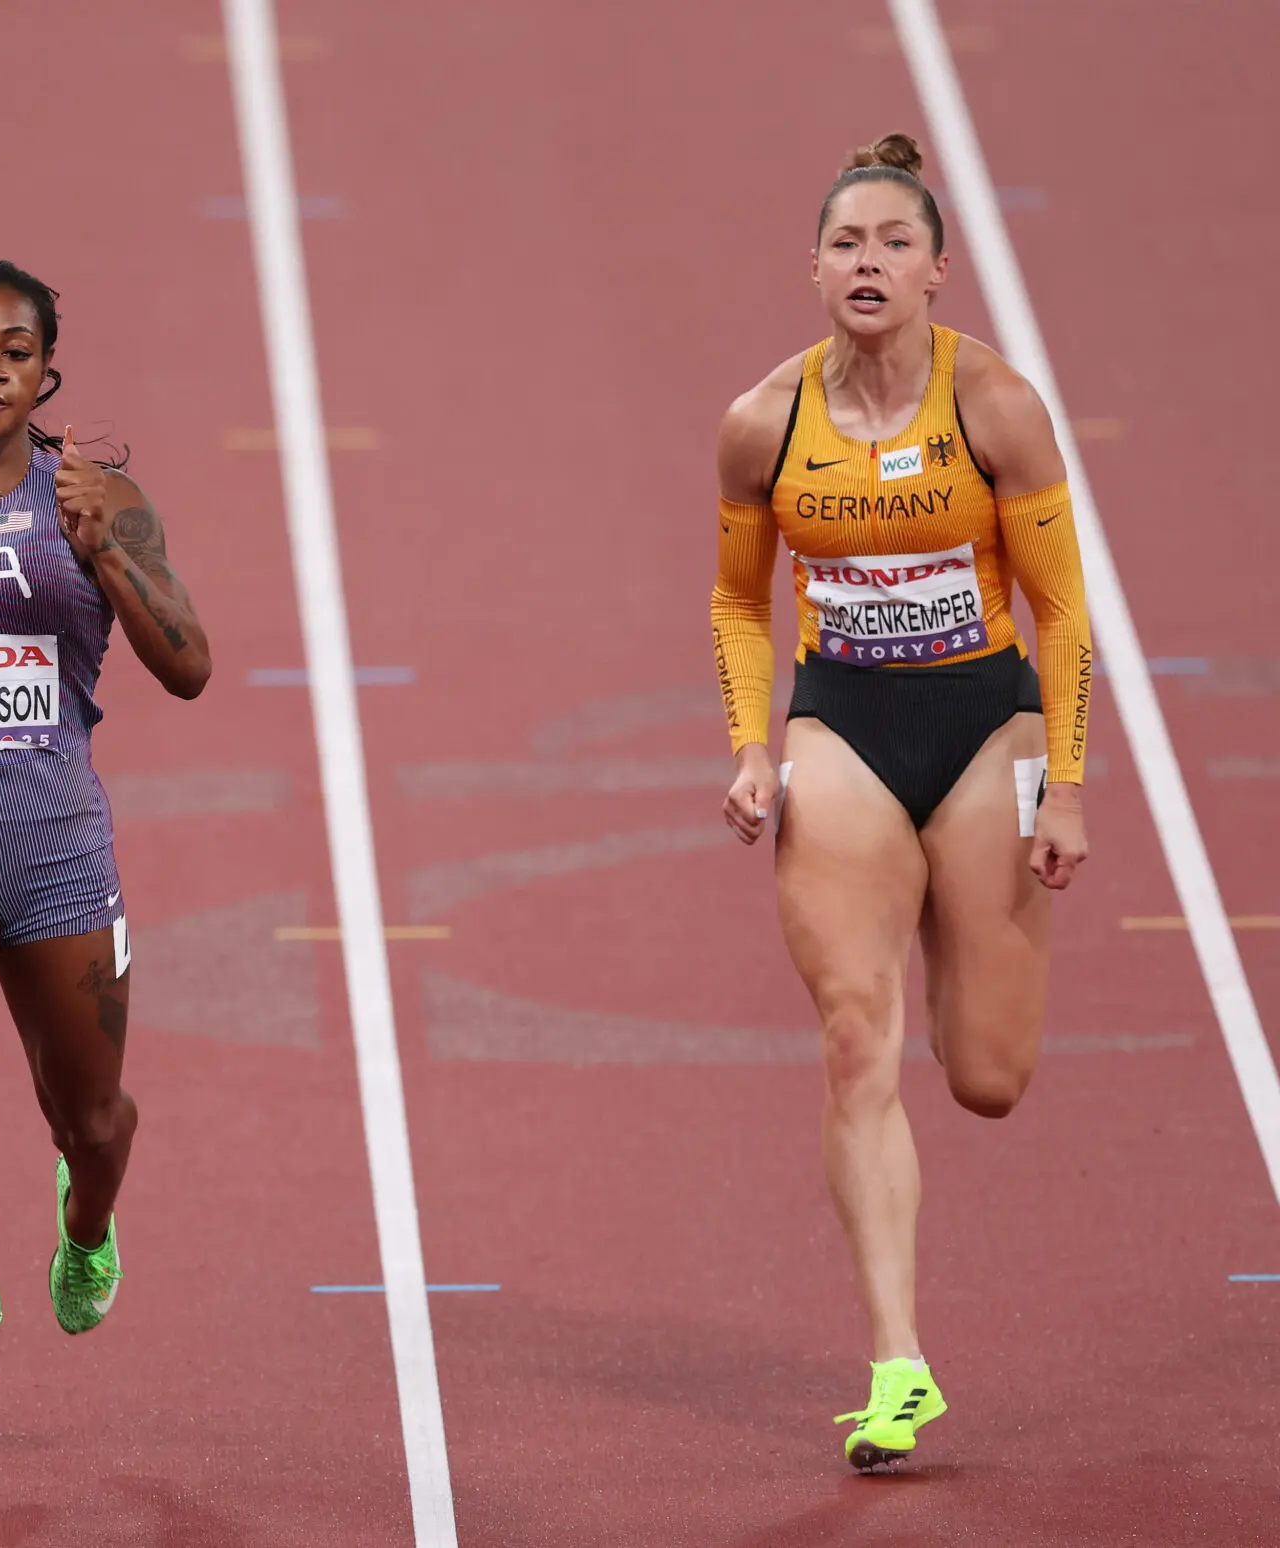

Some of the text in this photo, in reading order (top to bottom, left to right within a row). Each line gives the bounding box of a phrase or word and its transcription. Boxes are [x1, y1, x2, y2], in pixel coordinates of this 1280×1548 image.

[882, 453, 920, 473] WGV
[797, 486, 953, 520] GERMANY
[809, 558, 970, 588] HONDA
[1071, 644, 1093, 761] GERMANY
